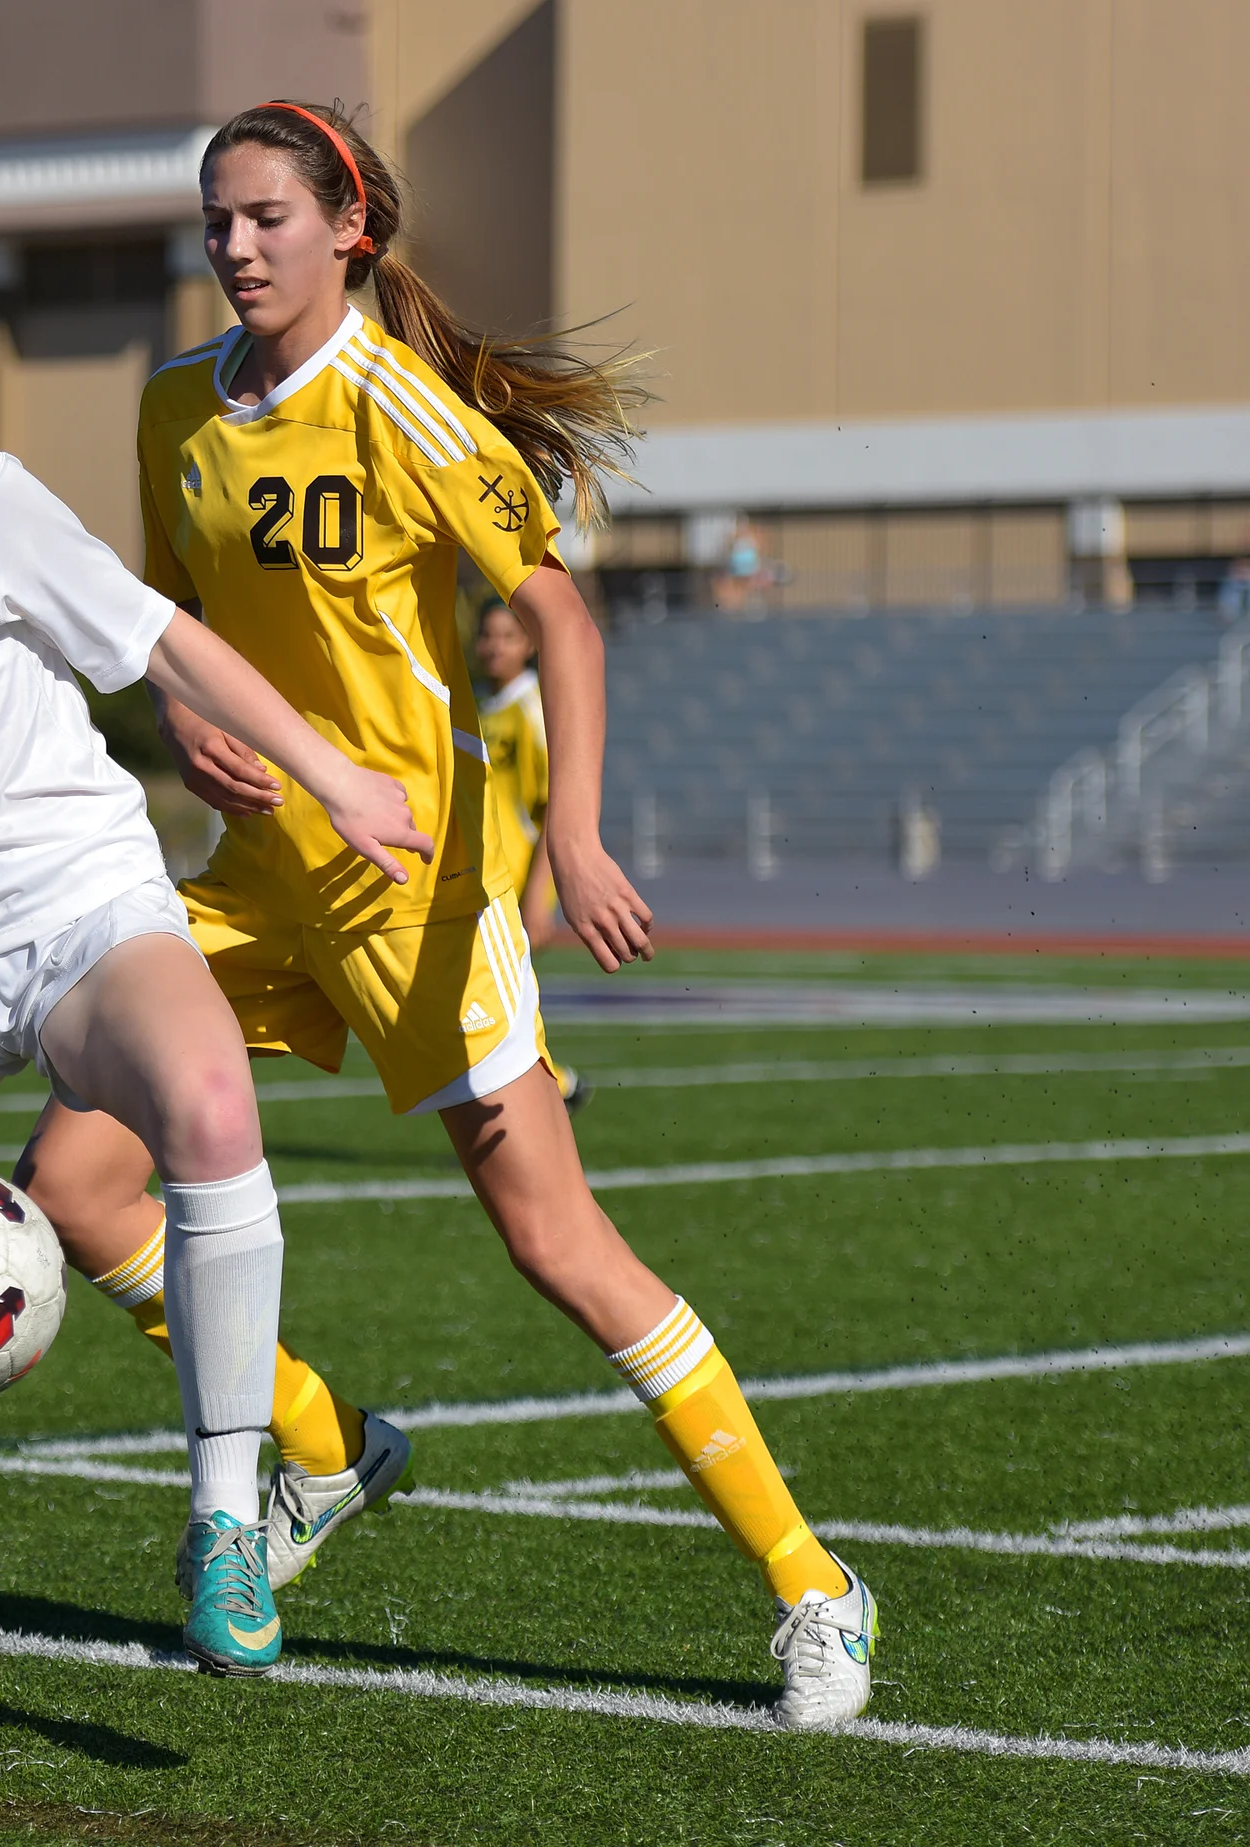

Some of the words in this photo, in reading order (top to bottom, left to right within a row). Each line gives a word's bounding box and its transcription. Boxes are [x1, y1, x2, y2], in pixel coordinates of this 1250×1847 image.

[248, 475, 363, 571] 20
[459, 1016, 496, 1033] adidas
[690, 1436, 747, 1473] adidas
